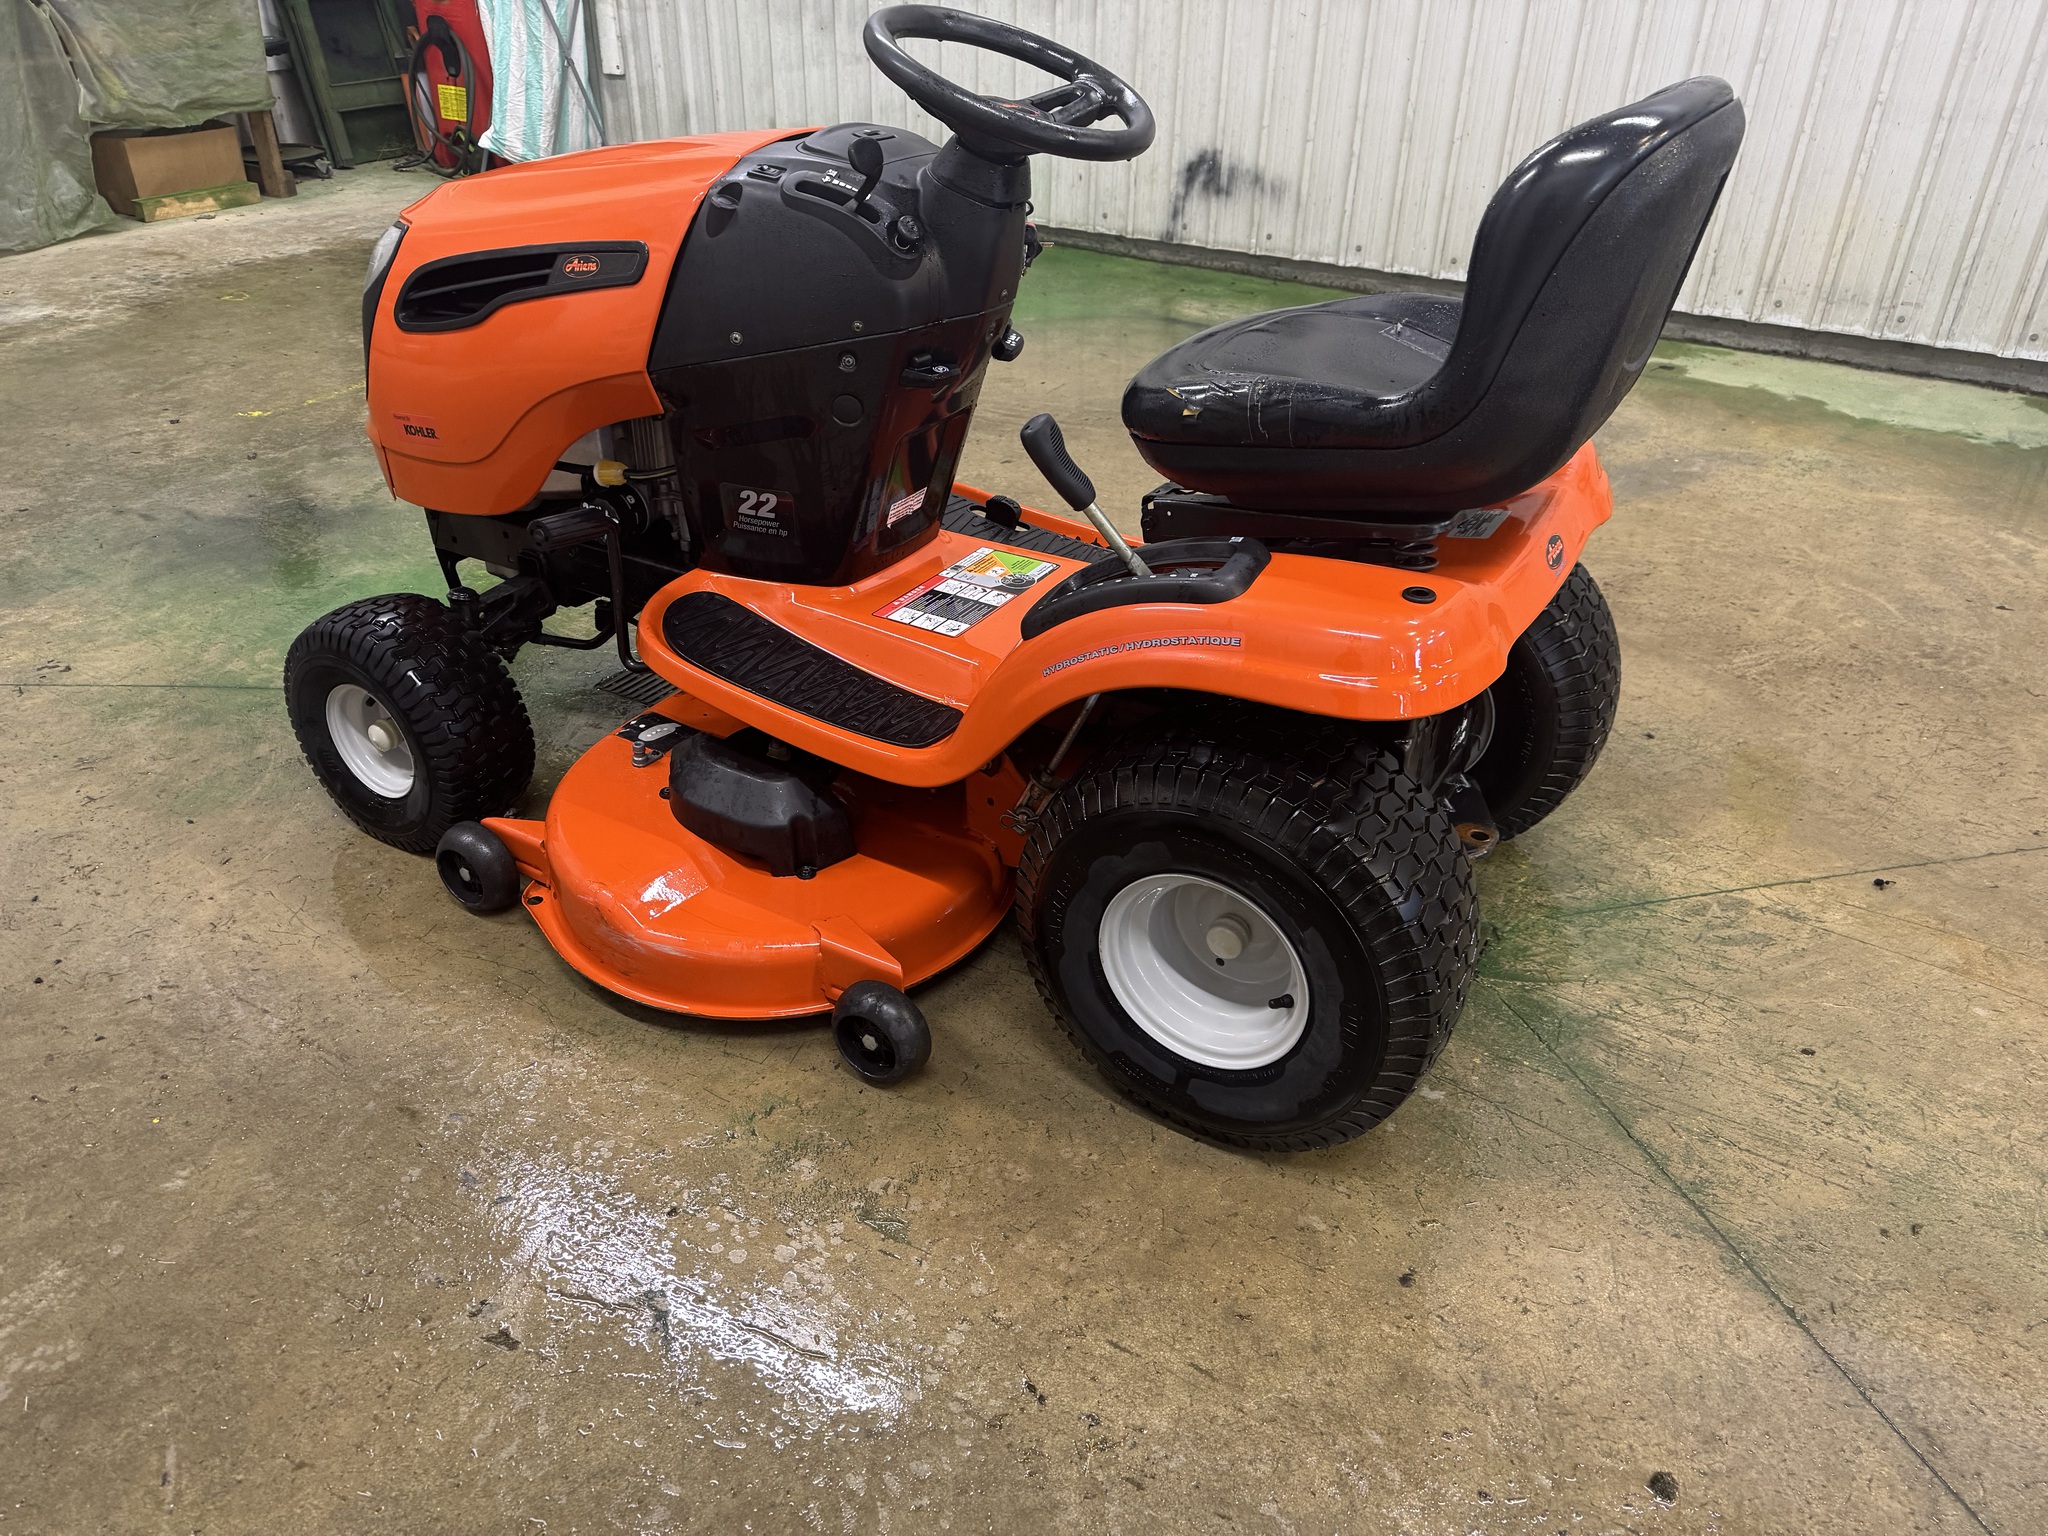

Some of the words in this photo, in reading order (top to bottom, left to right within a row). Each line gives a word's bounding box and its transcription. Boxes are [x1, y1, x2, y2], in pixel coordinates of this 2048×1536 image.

[565, 258, 597, 272] Ariens
[403, 424, 438, 439] KOHLER
[738, 490, 777, 518] 22
[733, 520, 767, 533] Puissance
[779, 529, 788, 537] hp
[739, 515, 779, 528] Horsepower
